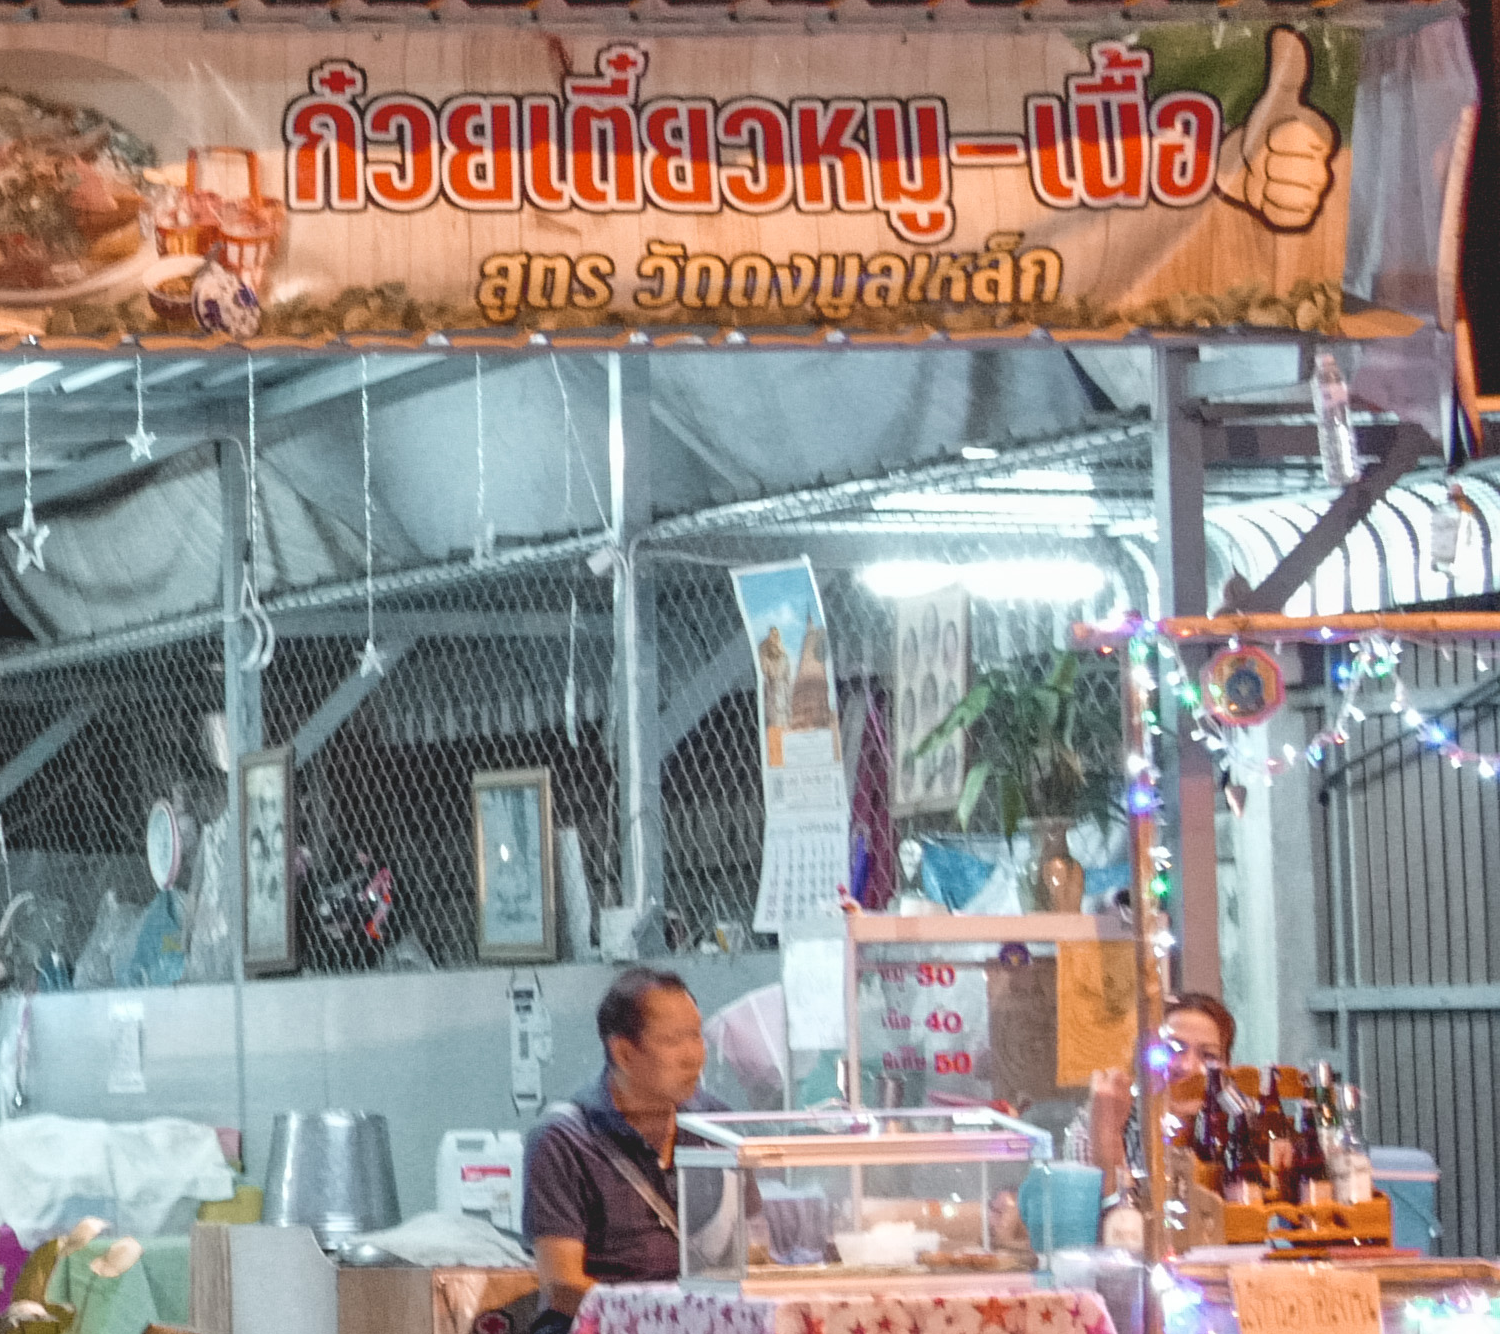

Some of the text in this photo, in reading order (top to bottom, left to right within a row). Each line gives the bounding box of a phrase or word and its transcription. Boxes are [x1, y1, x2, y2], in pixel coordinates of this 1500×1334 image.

[476, 230, 1064, 322] สูตร วัดดงมูลเหล็ก
[916, 963, 956, 988] 30
[926, 1011, 964, 1034] 40
[935, 1050, 973, 1075] 50
